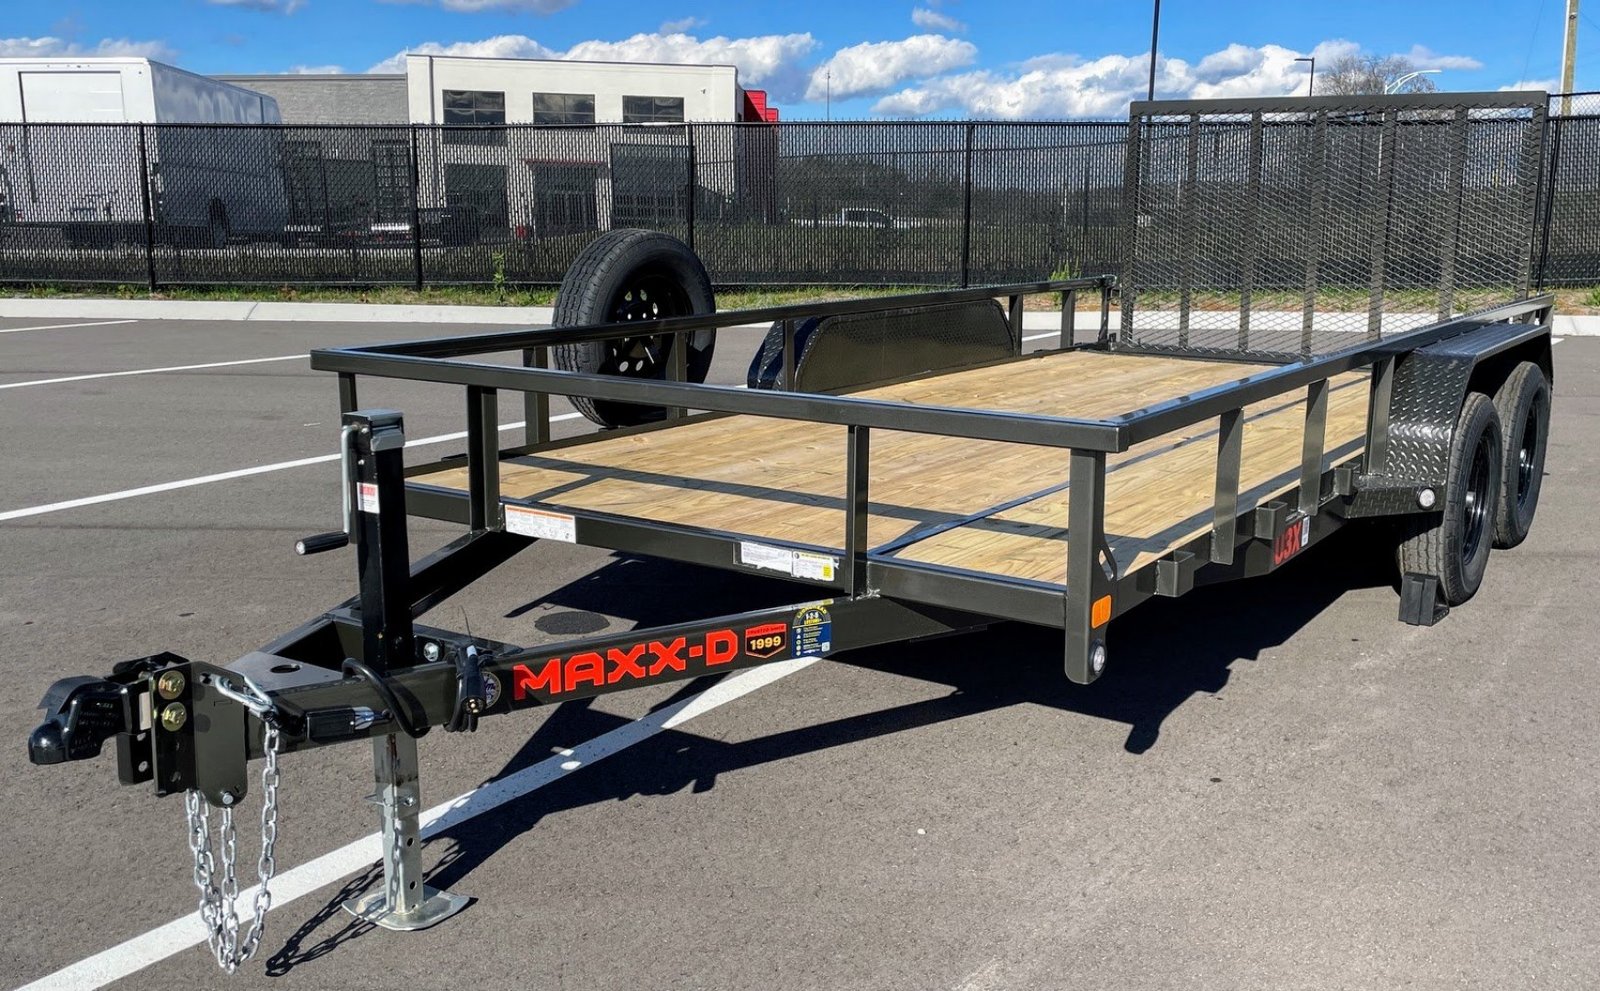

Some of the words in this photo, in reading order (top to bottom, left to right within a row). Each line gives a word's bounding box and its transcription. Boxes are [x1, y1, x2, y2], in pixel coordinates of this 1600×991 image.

[1273, 520, 1302, 565] U3X
[513, 629, 737, 700] MAXX-D
[750, 636, 781, 650] 1999
